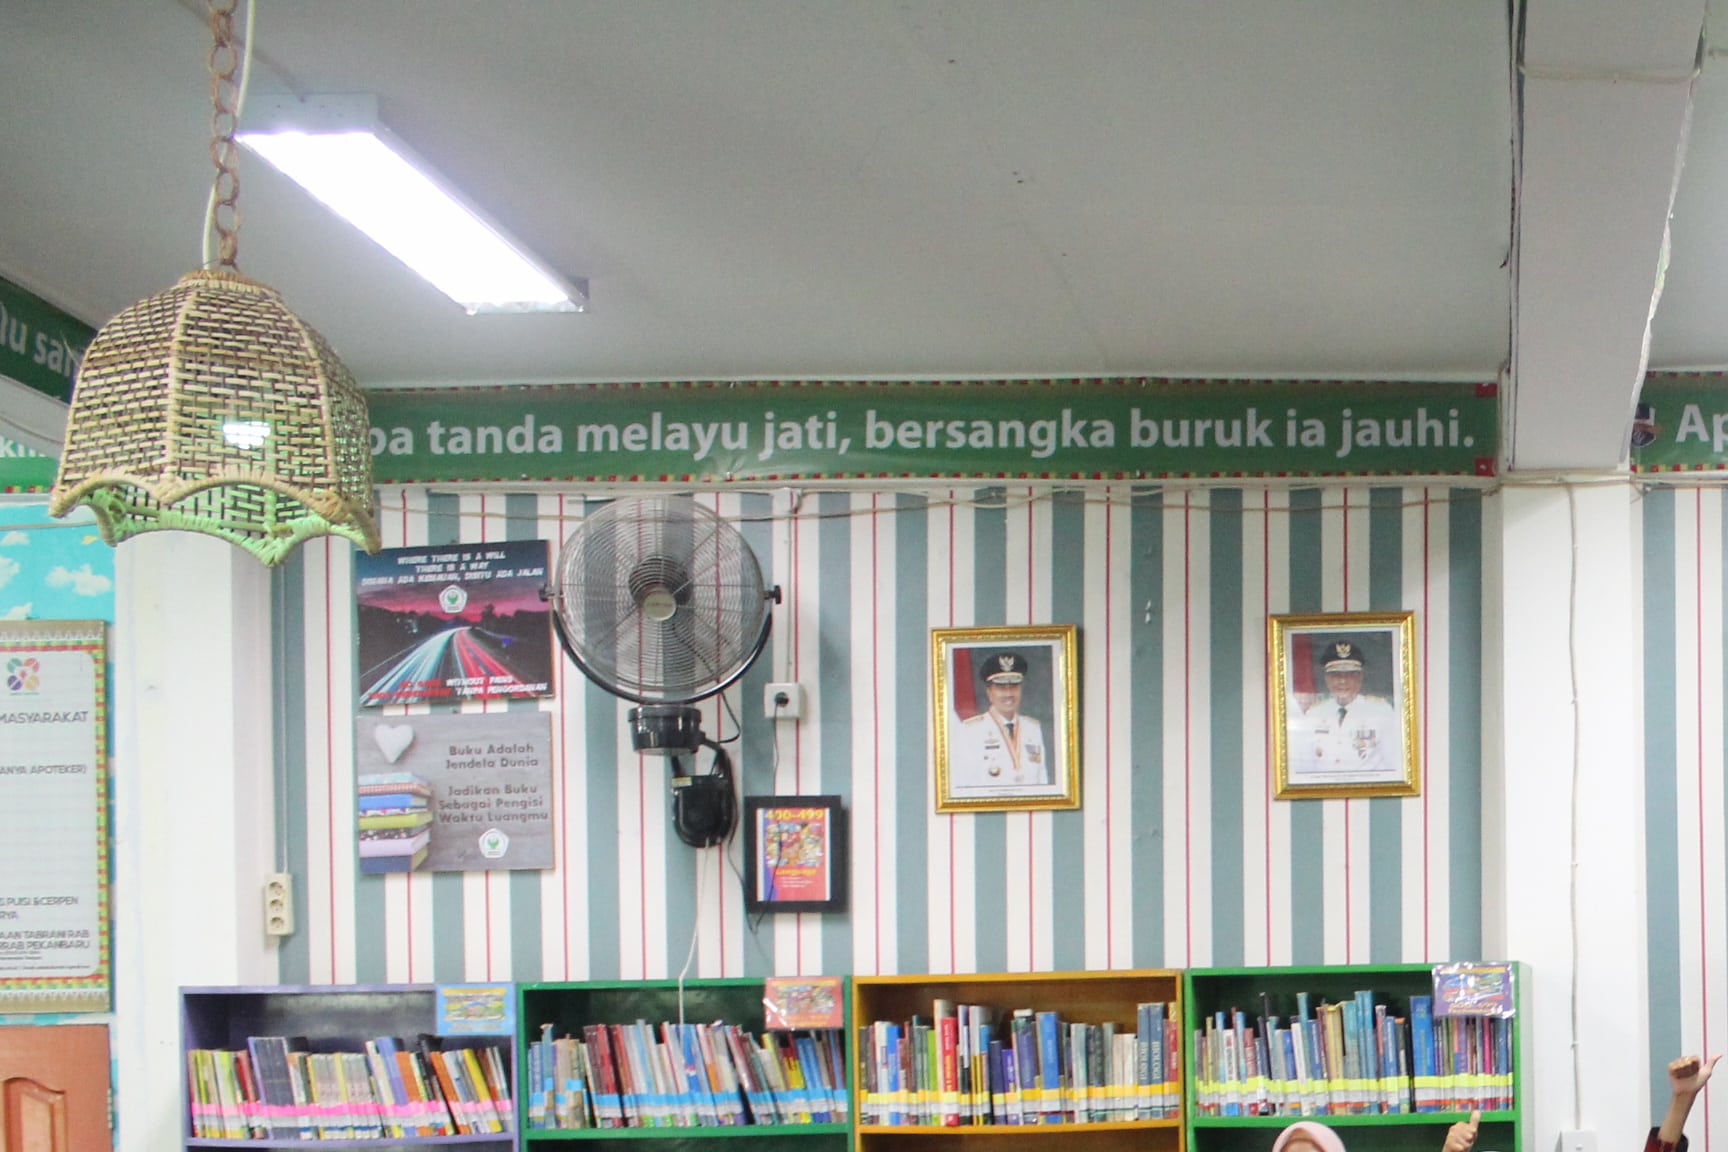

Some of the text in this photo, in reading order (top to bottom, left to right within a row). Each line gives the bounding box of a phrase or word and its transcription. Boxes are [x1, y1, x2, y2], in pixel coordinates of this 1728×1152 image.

[368, 408, 1474, 462] pa tanda melayu jati, bersangka buruk ia jauhi.
[449, 743, 534, 756] Buku Adalah
[446, 756, 539, 770] Jendela Dunia
[448, 783, 538, 797] Jadikan Buku
[438, 796, 543, 812] Sebagai Pengisi
[439, 809, 549, 824] Waktu Luangmu
